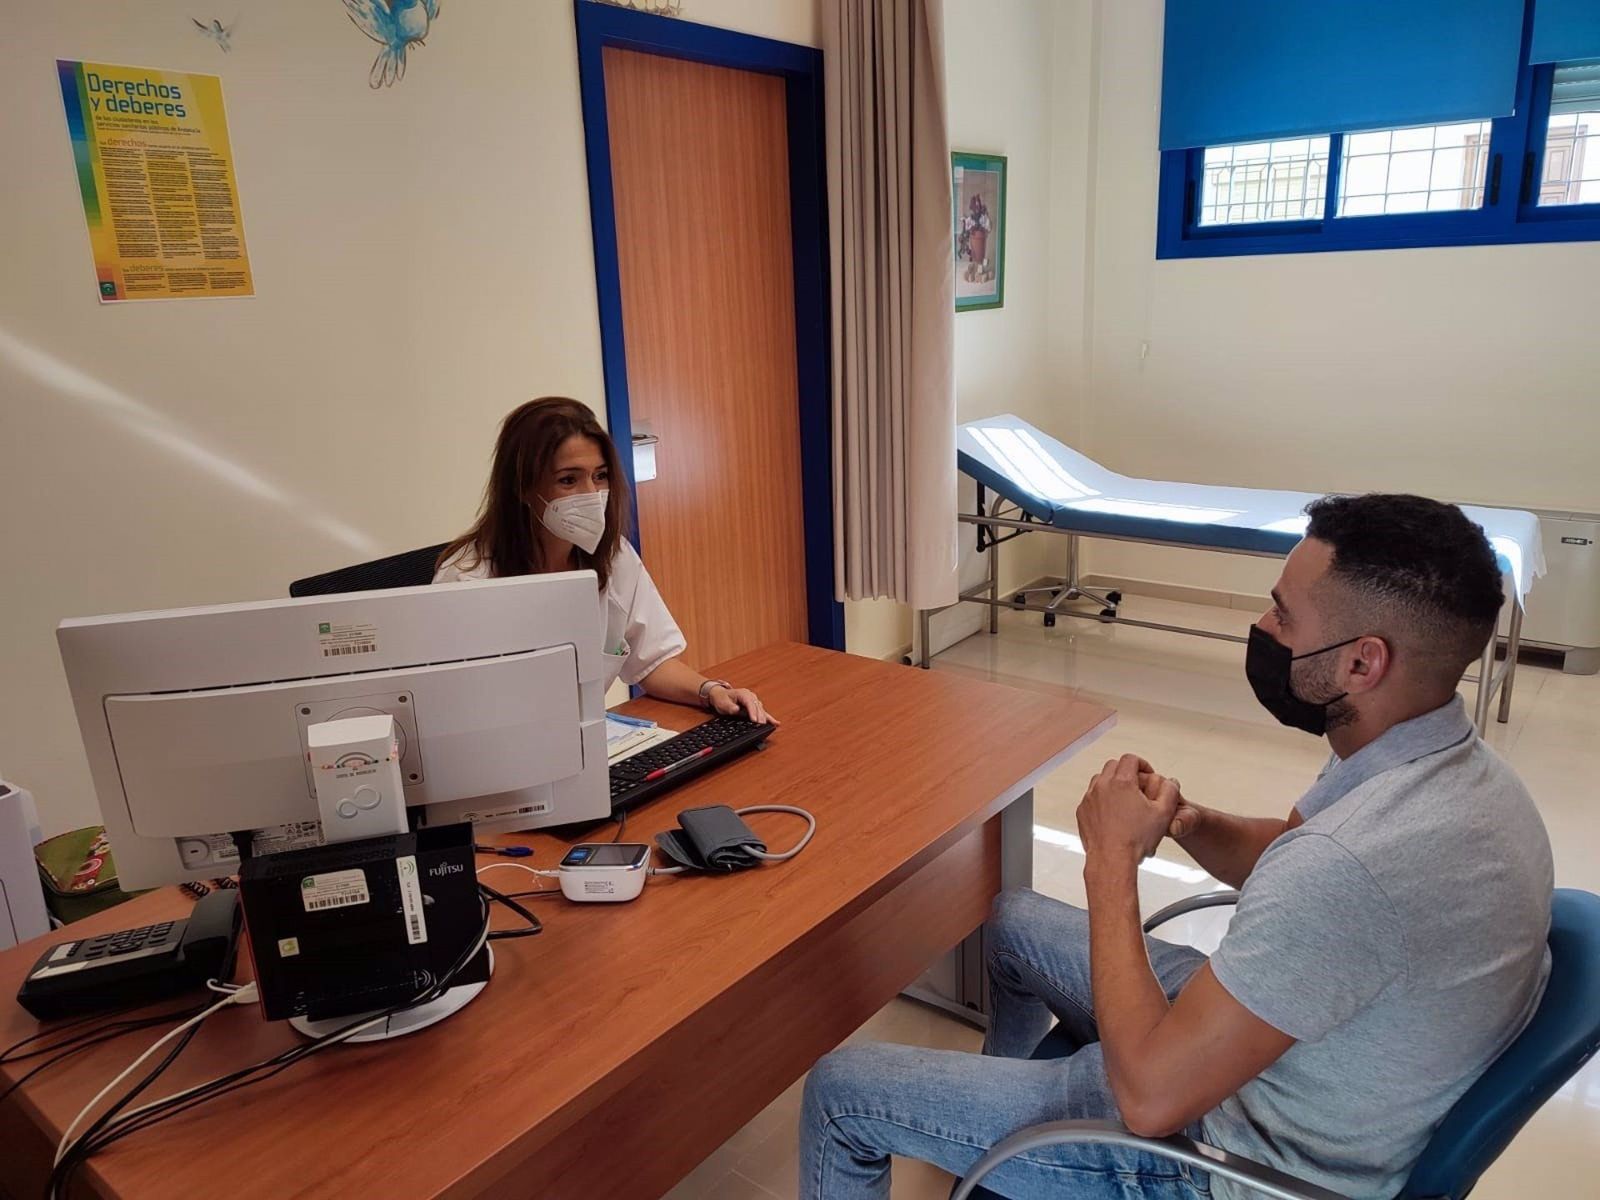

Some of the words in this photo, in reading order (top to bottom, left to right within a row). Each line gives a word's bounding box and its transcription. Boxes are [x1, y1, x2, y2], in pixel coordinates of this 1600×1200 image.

[87, 73, 182, 99] Derechos
[90, 96, 101, 111] y
[105, 94, 187, 117] deberes
[429, 861, 464, 877] FUJITSU
